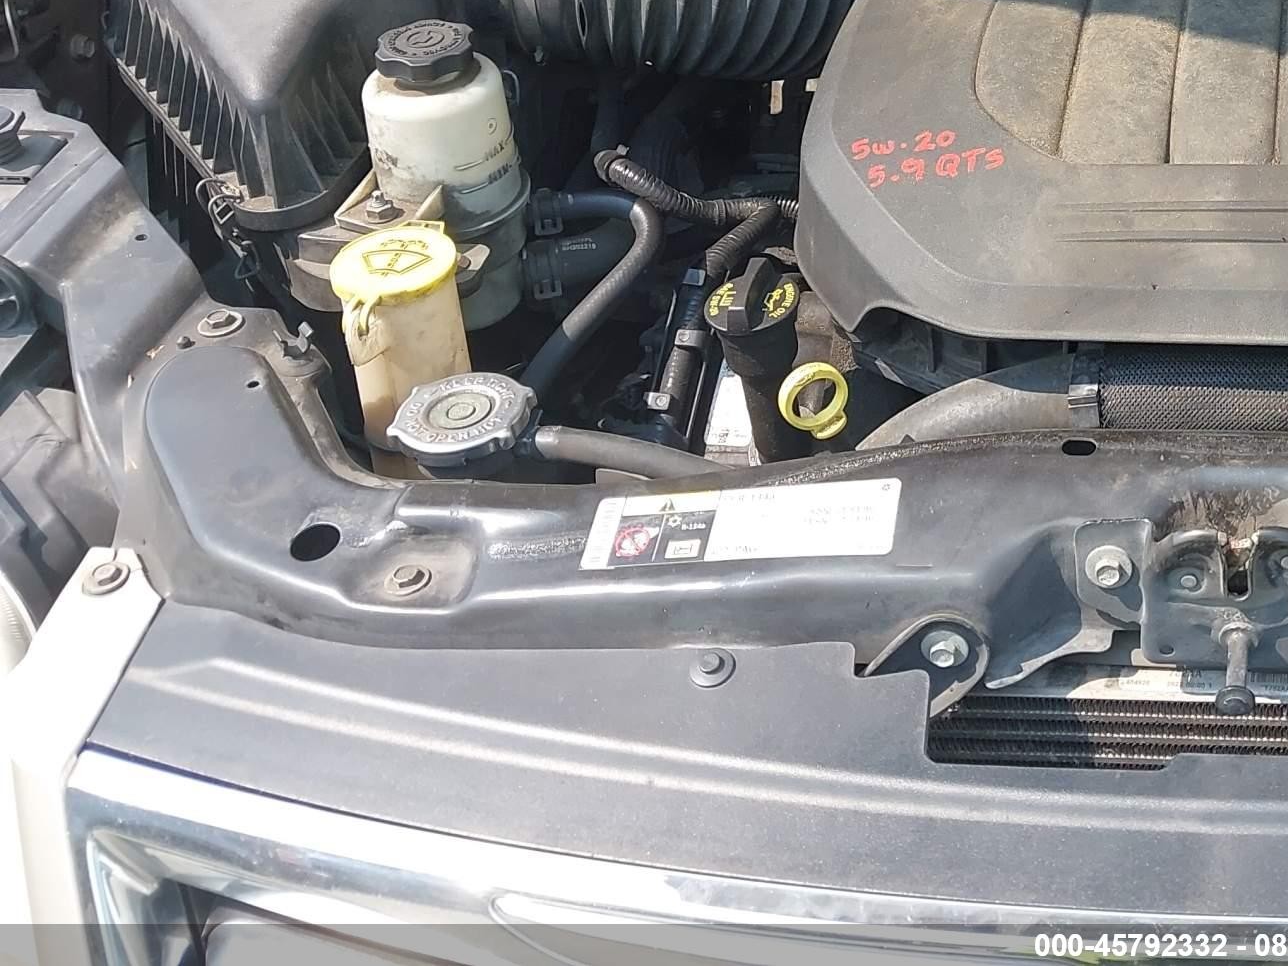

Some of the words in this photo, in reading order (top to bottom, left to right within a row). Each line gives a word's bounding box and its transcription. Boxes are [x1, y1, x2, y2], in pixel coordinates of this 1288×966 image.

[867, 157, 925, 188] 5.9
[935, 147, 1005, 177] QTS
[783, 283, 795, 308] ENGINE
[768, 307, 786, 318] OIL
